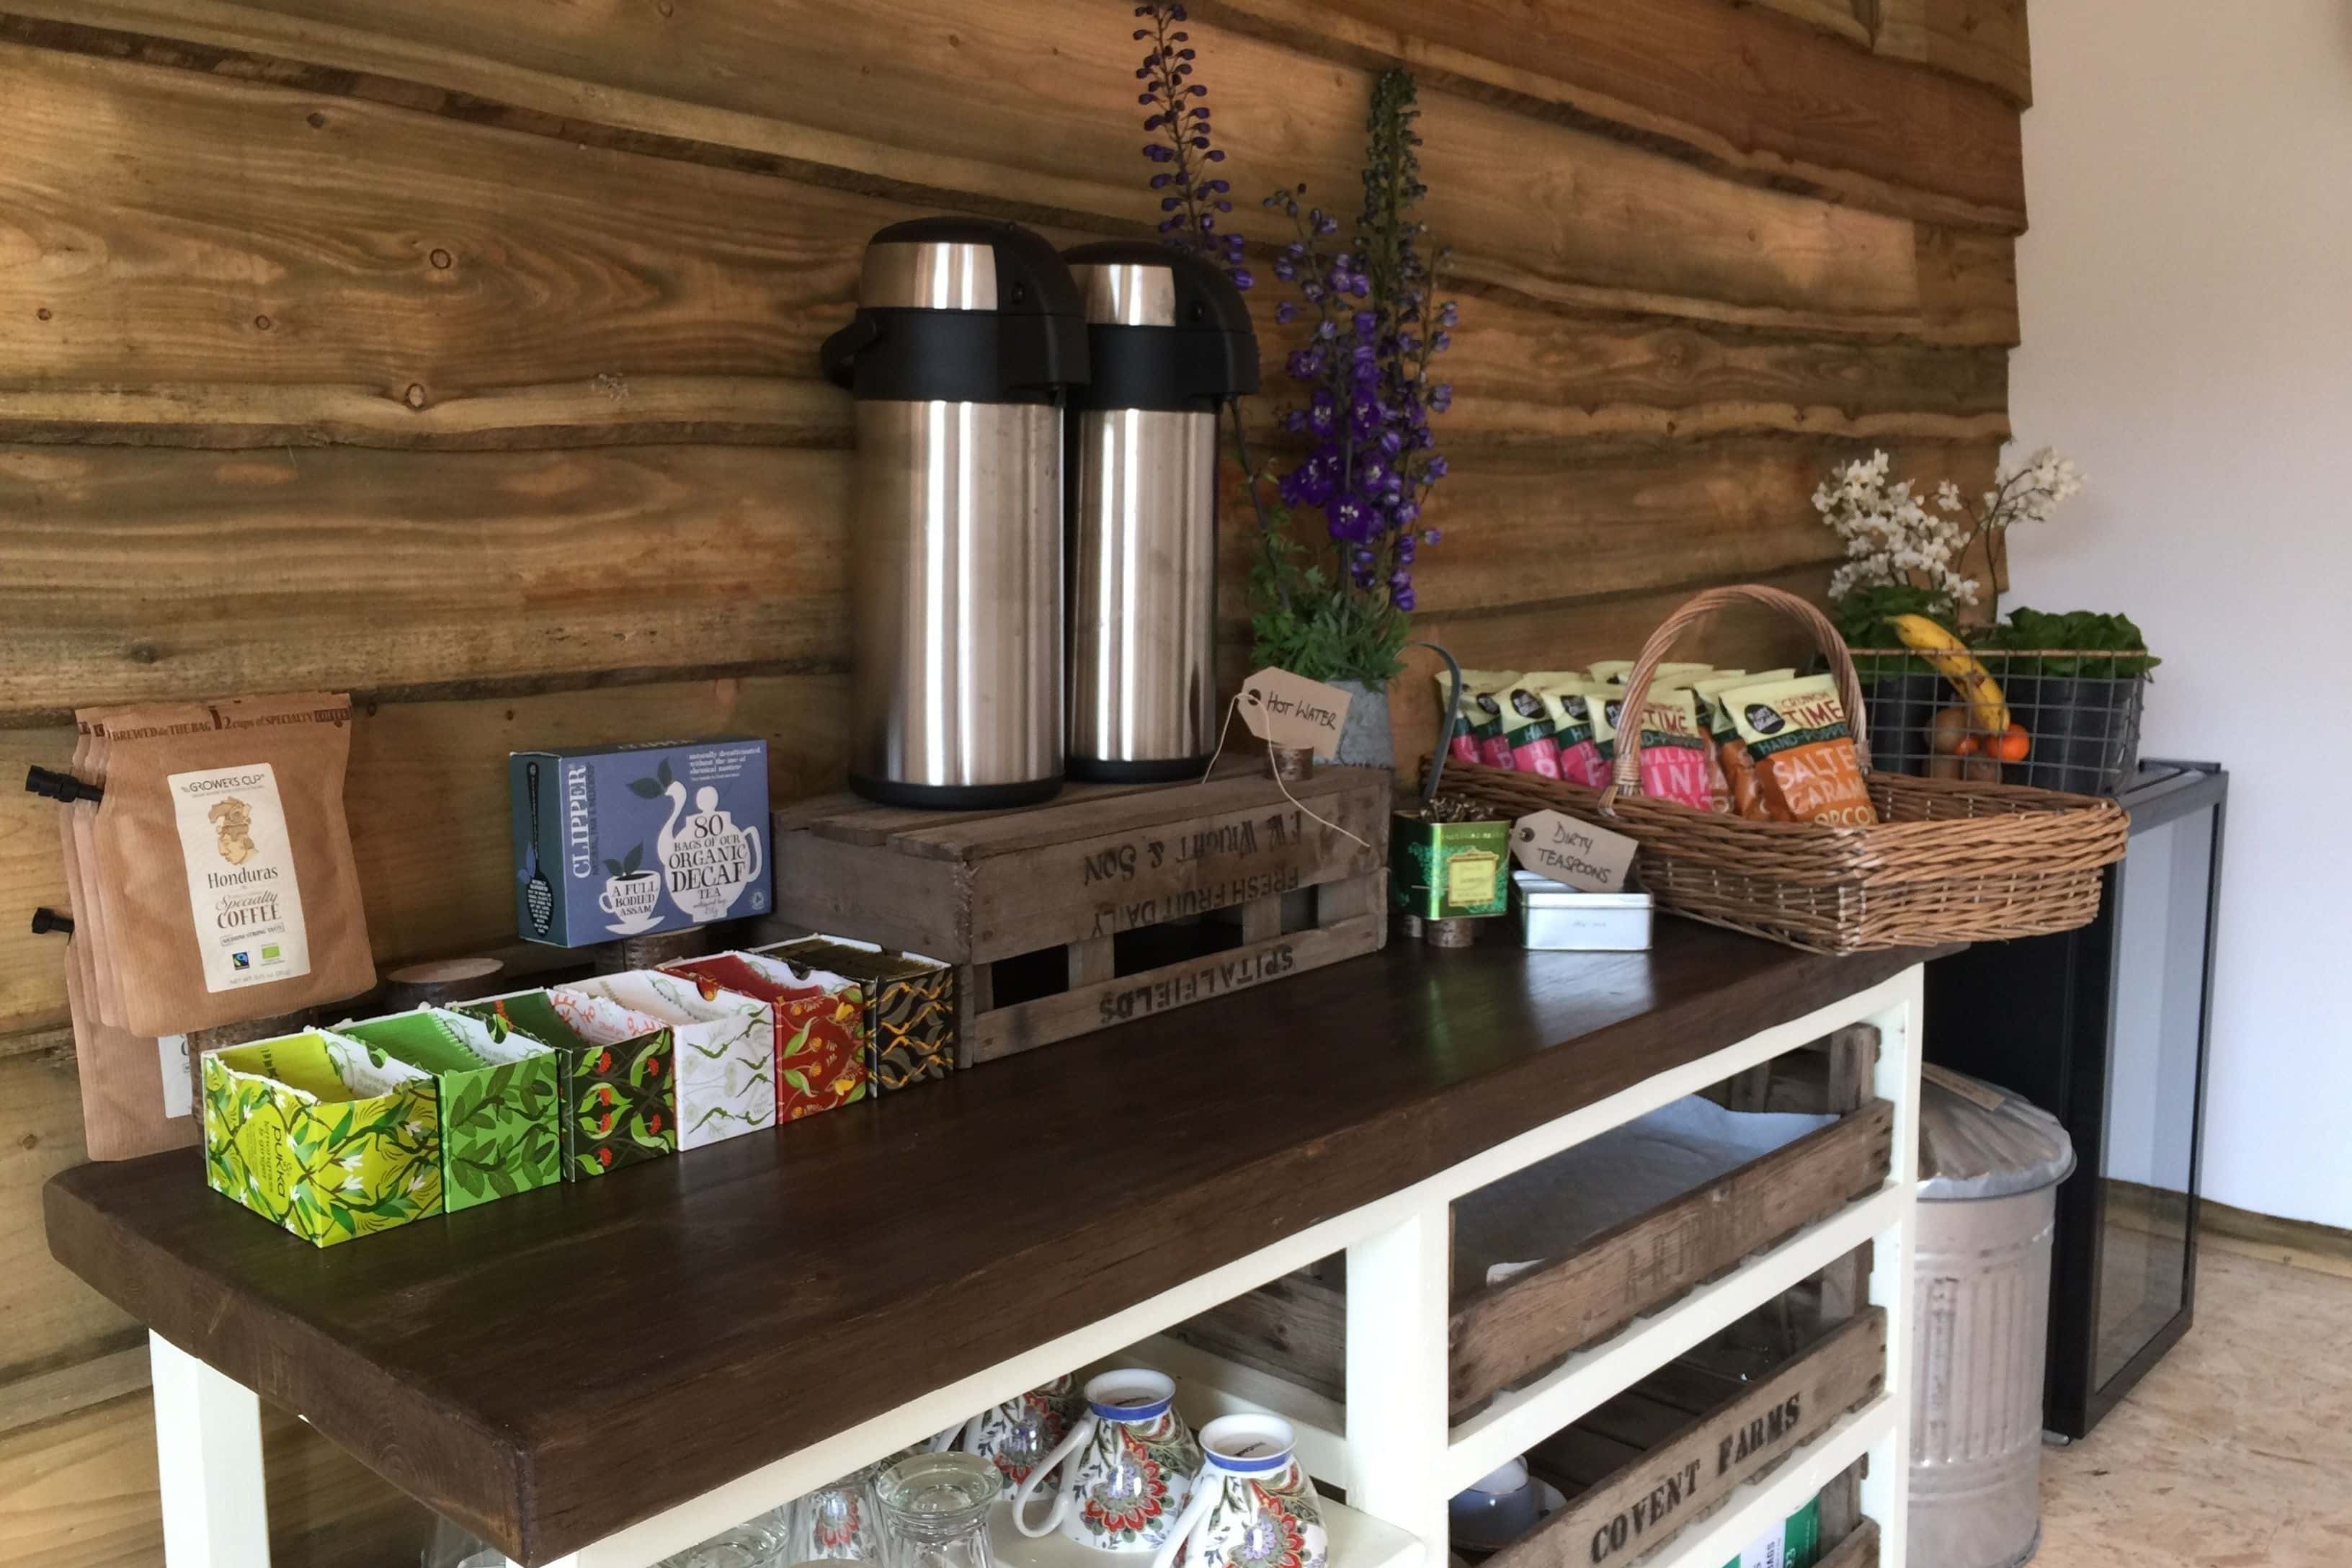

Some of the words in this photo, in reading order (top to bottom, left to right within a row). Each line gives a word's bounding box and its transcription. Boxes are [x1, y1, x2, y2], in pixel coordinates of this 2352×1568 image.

[264, 712, 314, 728] SPECIALTY
[1267, 690, 1294, 715] HOT
[1296, 700, 1337, 730] WATER
[1642, 709, 1690, 736] TIME
[1781, 700, 1845, 728] TIME
[112, 728, 157, 741] BREWED
[169, 723, 190, 736] THE
[190, 721, 211, 734] BAG
[1773, 744, 1857, 790] SALTE
[569, 765, 592, 878] CLIPPER
[693, 814, 724, 839] 80
[674, 840, 702, 852] BAGS
[703, 837, 718, 848] OF
[720, 834, 741, 845] OUR
[1176, 819, 1258, 862] WRIGHT
[1553, 821, 1595, 855] DIRTY
[669, 844, 748, 869] ORGANIC
[1083, 844, 1136, 886] SON
[1148, 840, 1165, 869] &
[1537, 847, 1613, 884] TEASPOONS
[208, 866, 278, 889] Honduras
[612, 885, 623, 897] A
[625, 881, 659, 896] FULL
[672, 861, 747, 893] DECAF
[1233, 867, 1299, 901] FRESH
[215, 890, 278, 916] Specialty
[615, 894, 656, 908] BODIED
[698, 888, 722, 900] TEA
[1164, 883, 1226, 919] FRUIT
[217, 904, 282, 929] COFFEE
[620, 904, 652, 917] ASSAM
[1090, 901, 1156, 939] DAILY
[1099, 943, 1293, 1024] SPITALFIELDS
[272, 1125, 286, 1198] pukka
[1591, 1458, 1701, 1564] COVENT
[1718, 1391, 1801, 1476] FARMS
